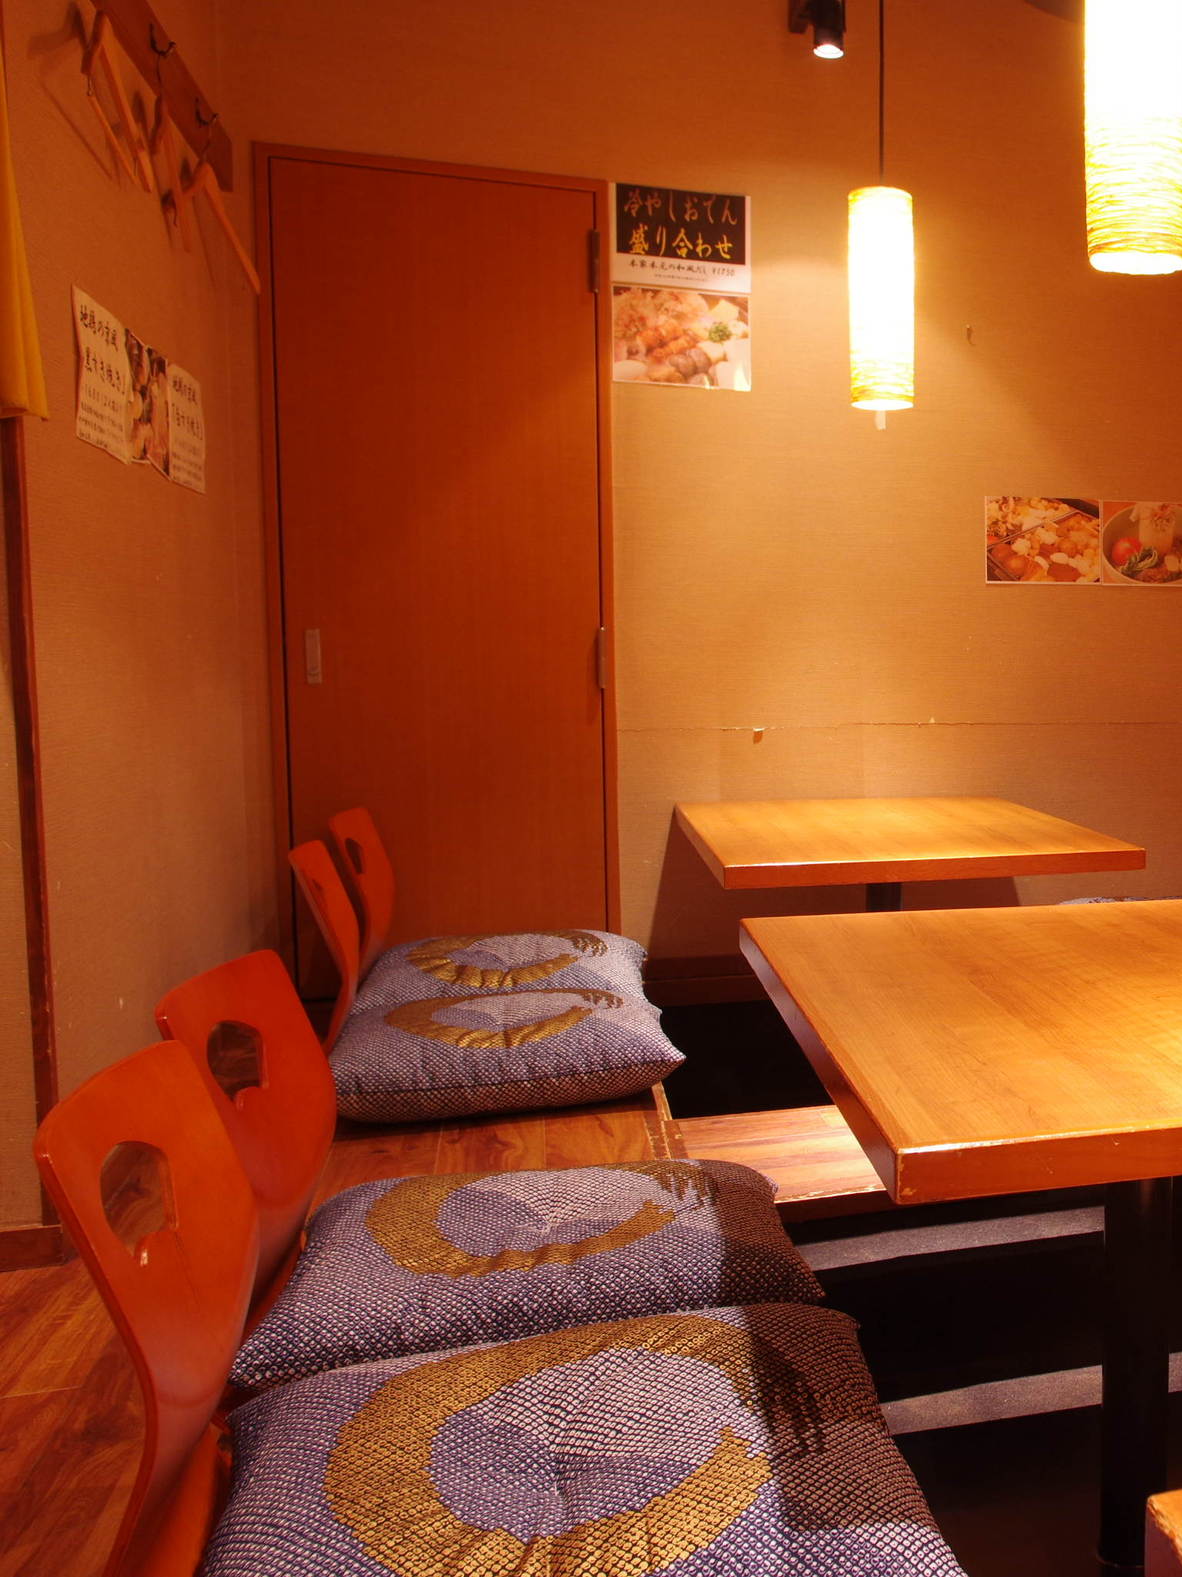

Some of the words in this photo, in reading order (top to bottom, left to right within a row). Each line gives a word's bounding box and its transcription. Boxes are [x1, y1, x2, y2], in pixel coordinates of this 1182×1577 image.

[628, 223, 733, 260] 盛り合わせ
